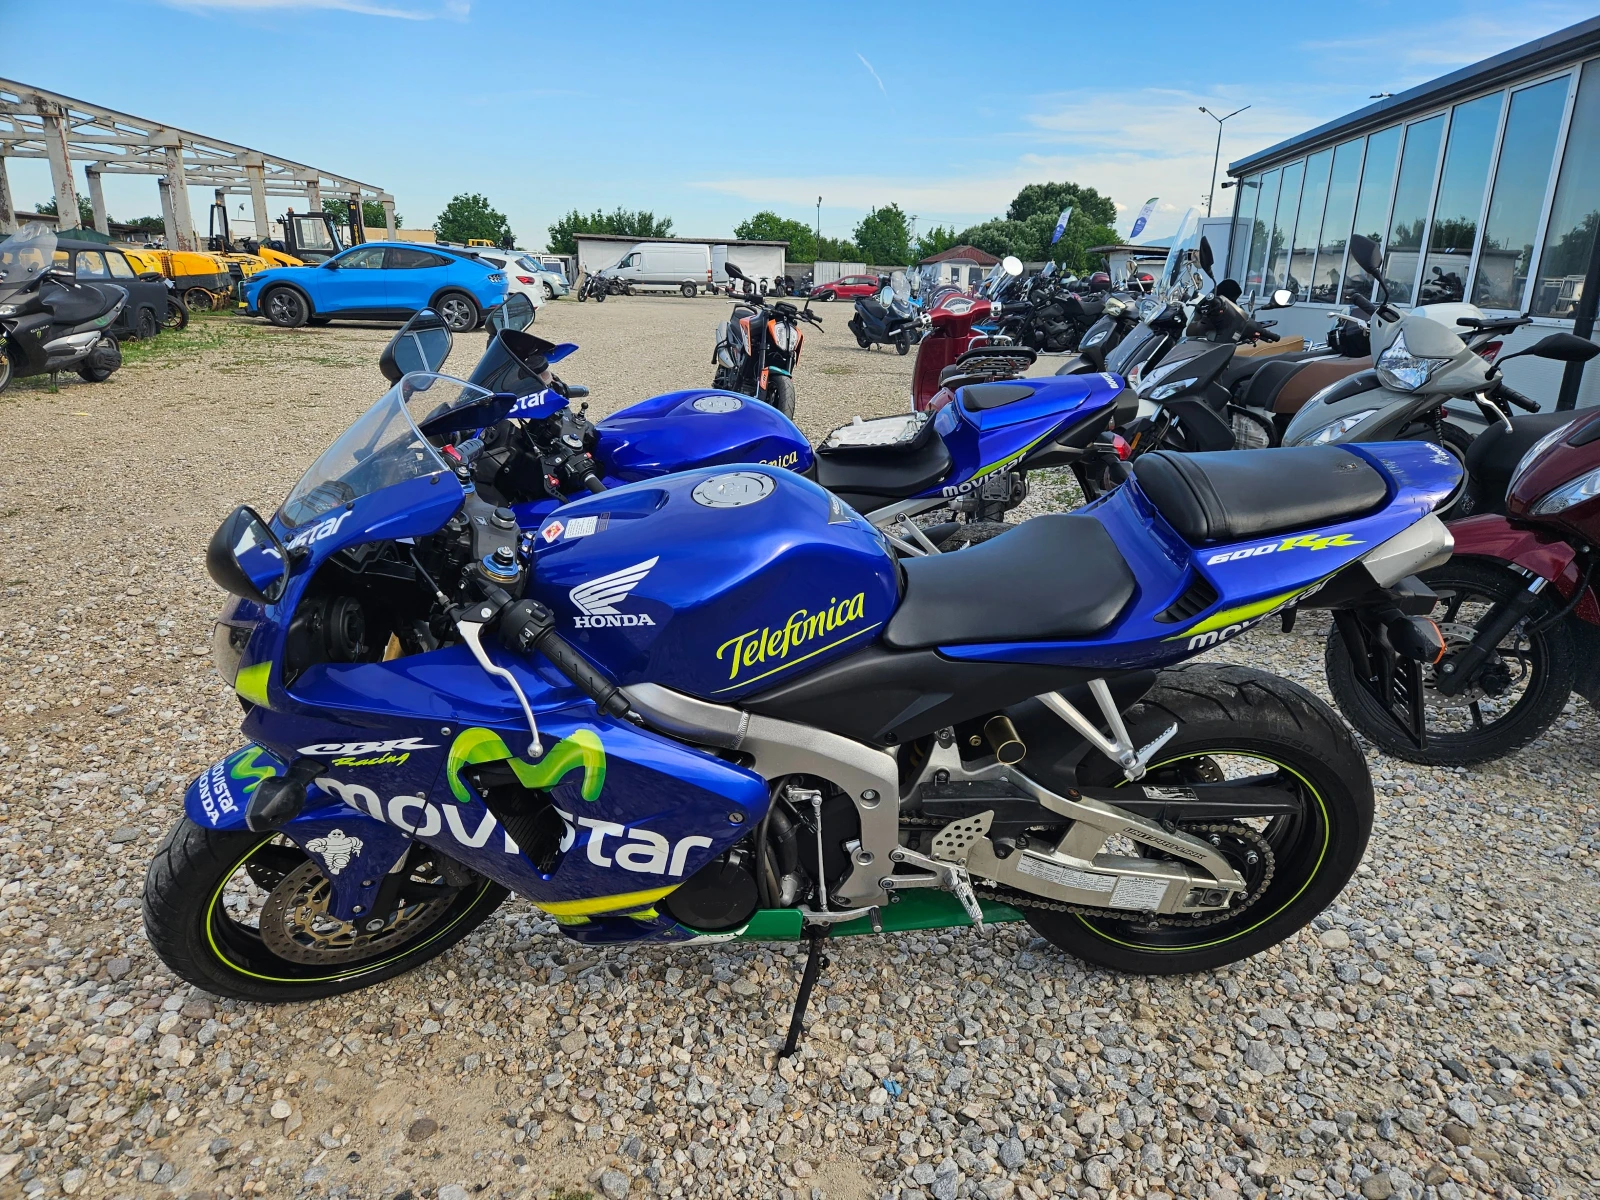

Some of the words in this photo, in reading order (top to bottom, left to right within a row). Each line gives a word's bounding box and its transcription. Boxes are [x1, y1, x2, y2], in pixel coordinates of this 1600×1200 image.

[942, 451, 1027, 498] movistar
[573, 613, 656, 629] HONDA
[296, 736, 442, 757] CBR
[331, 751, 411, 767] Racing
[198, 767, 220, 827] HONDA
[211, 758, 239, 815] movistar
